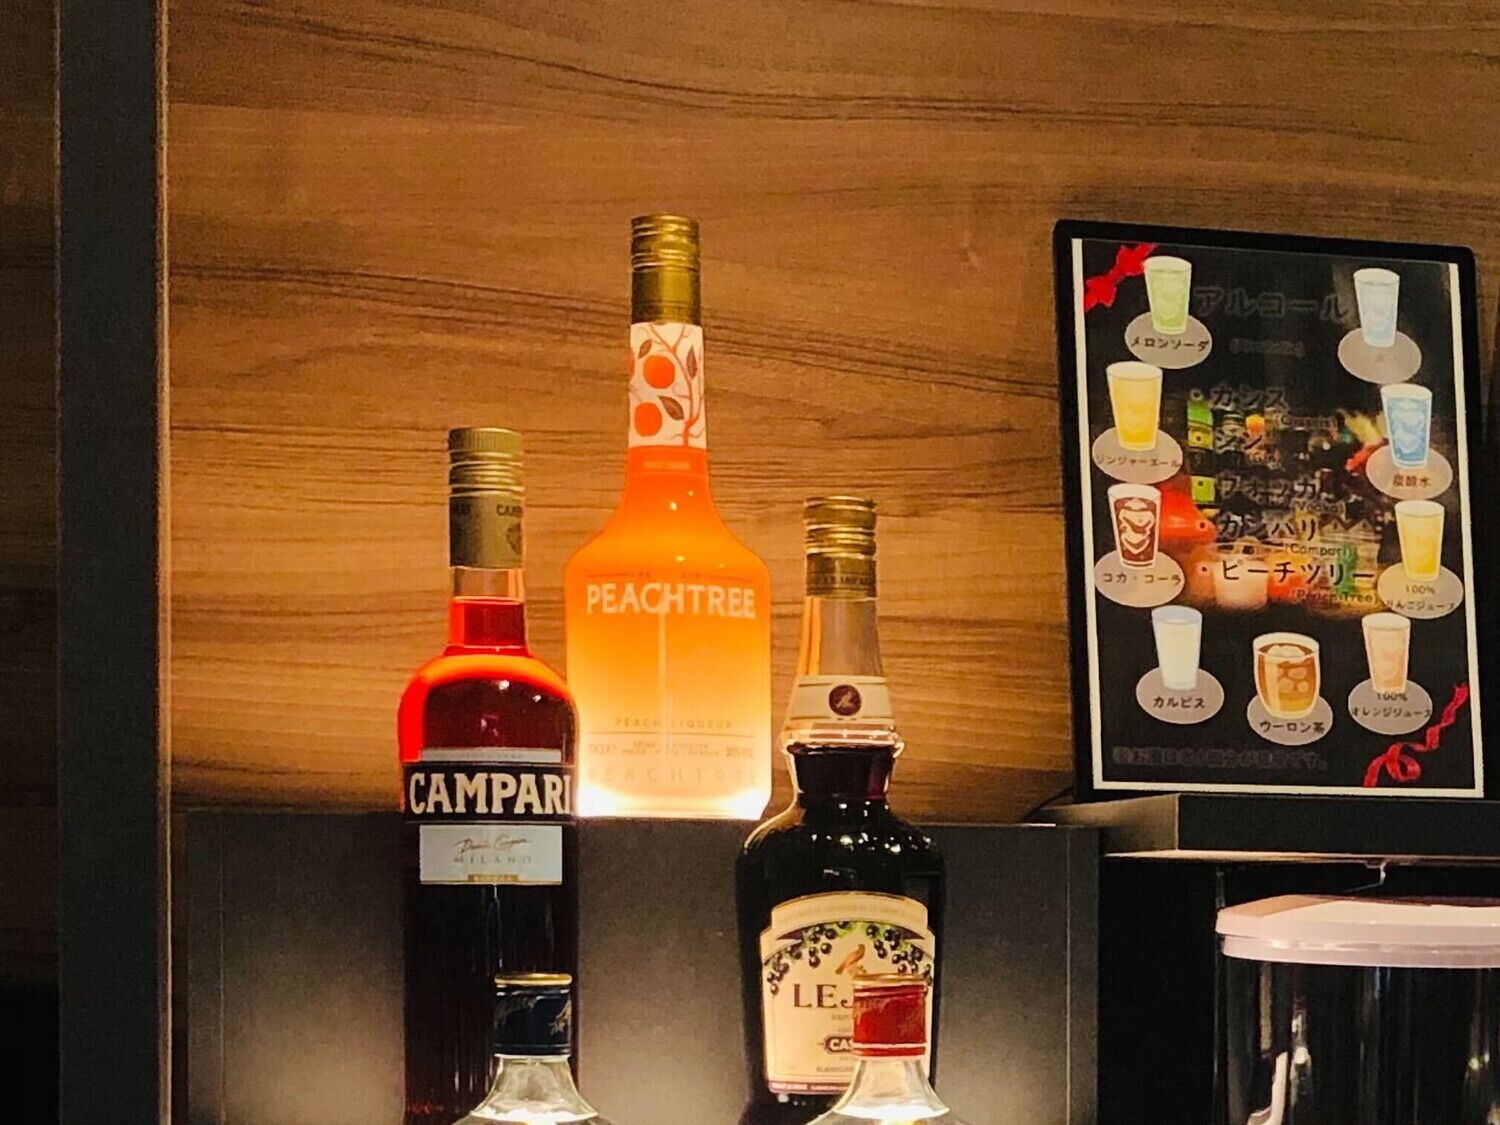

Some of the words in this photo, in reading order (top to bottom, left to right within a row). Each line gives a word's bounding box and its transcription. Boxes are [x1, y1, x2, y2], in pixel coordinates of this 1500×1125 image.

[1130, 336, 1209, 352] メロンソーダ
[1102, 570, 1182, 587] コカ・コーラ
[586, 582, 756, 620] PEACHTREE
[1152, 695, 1206, 711] カルピス
[615, 716, 662, 728] PEACH
[409, 772, 572, 815] CAMPARI
